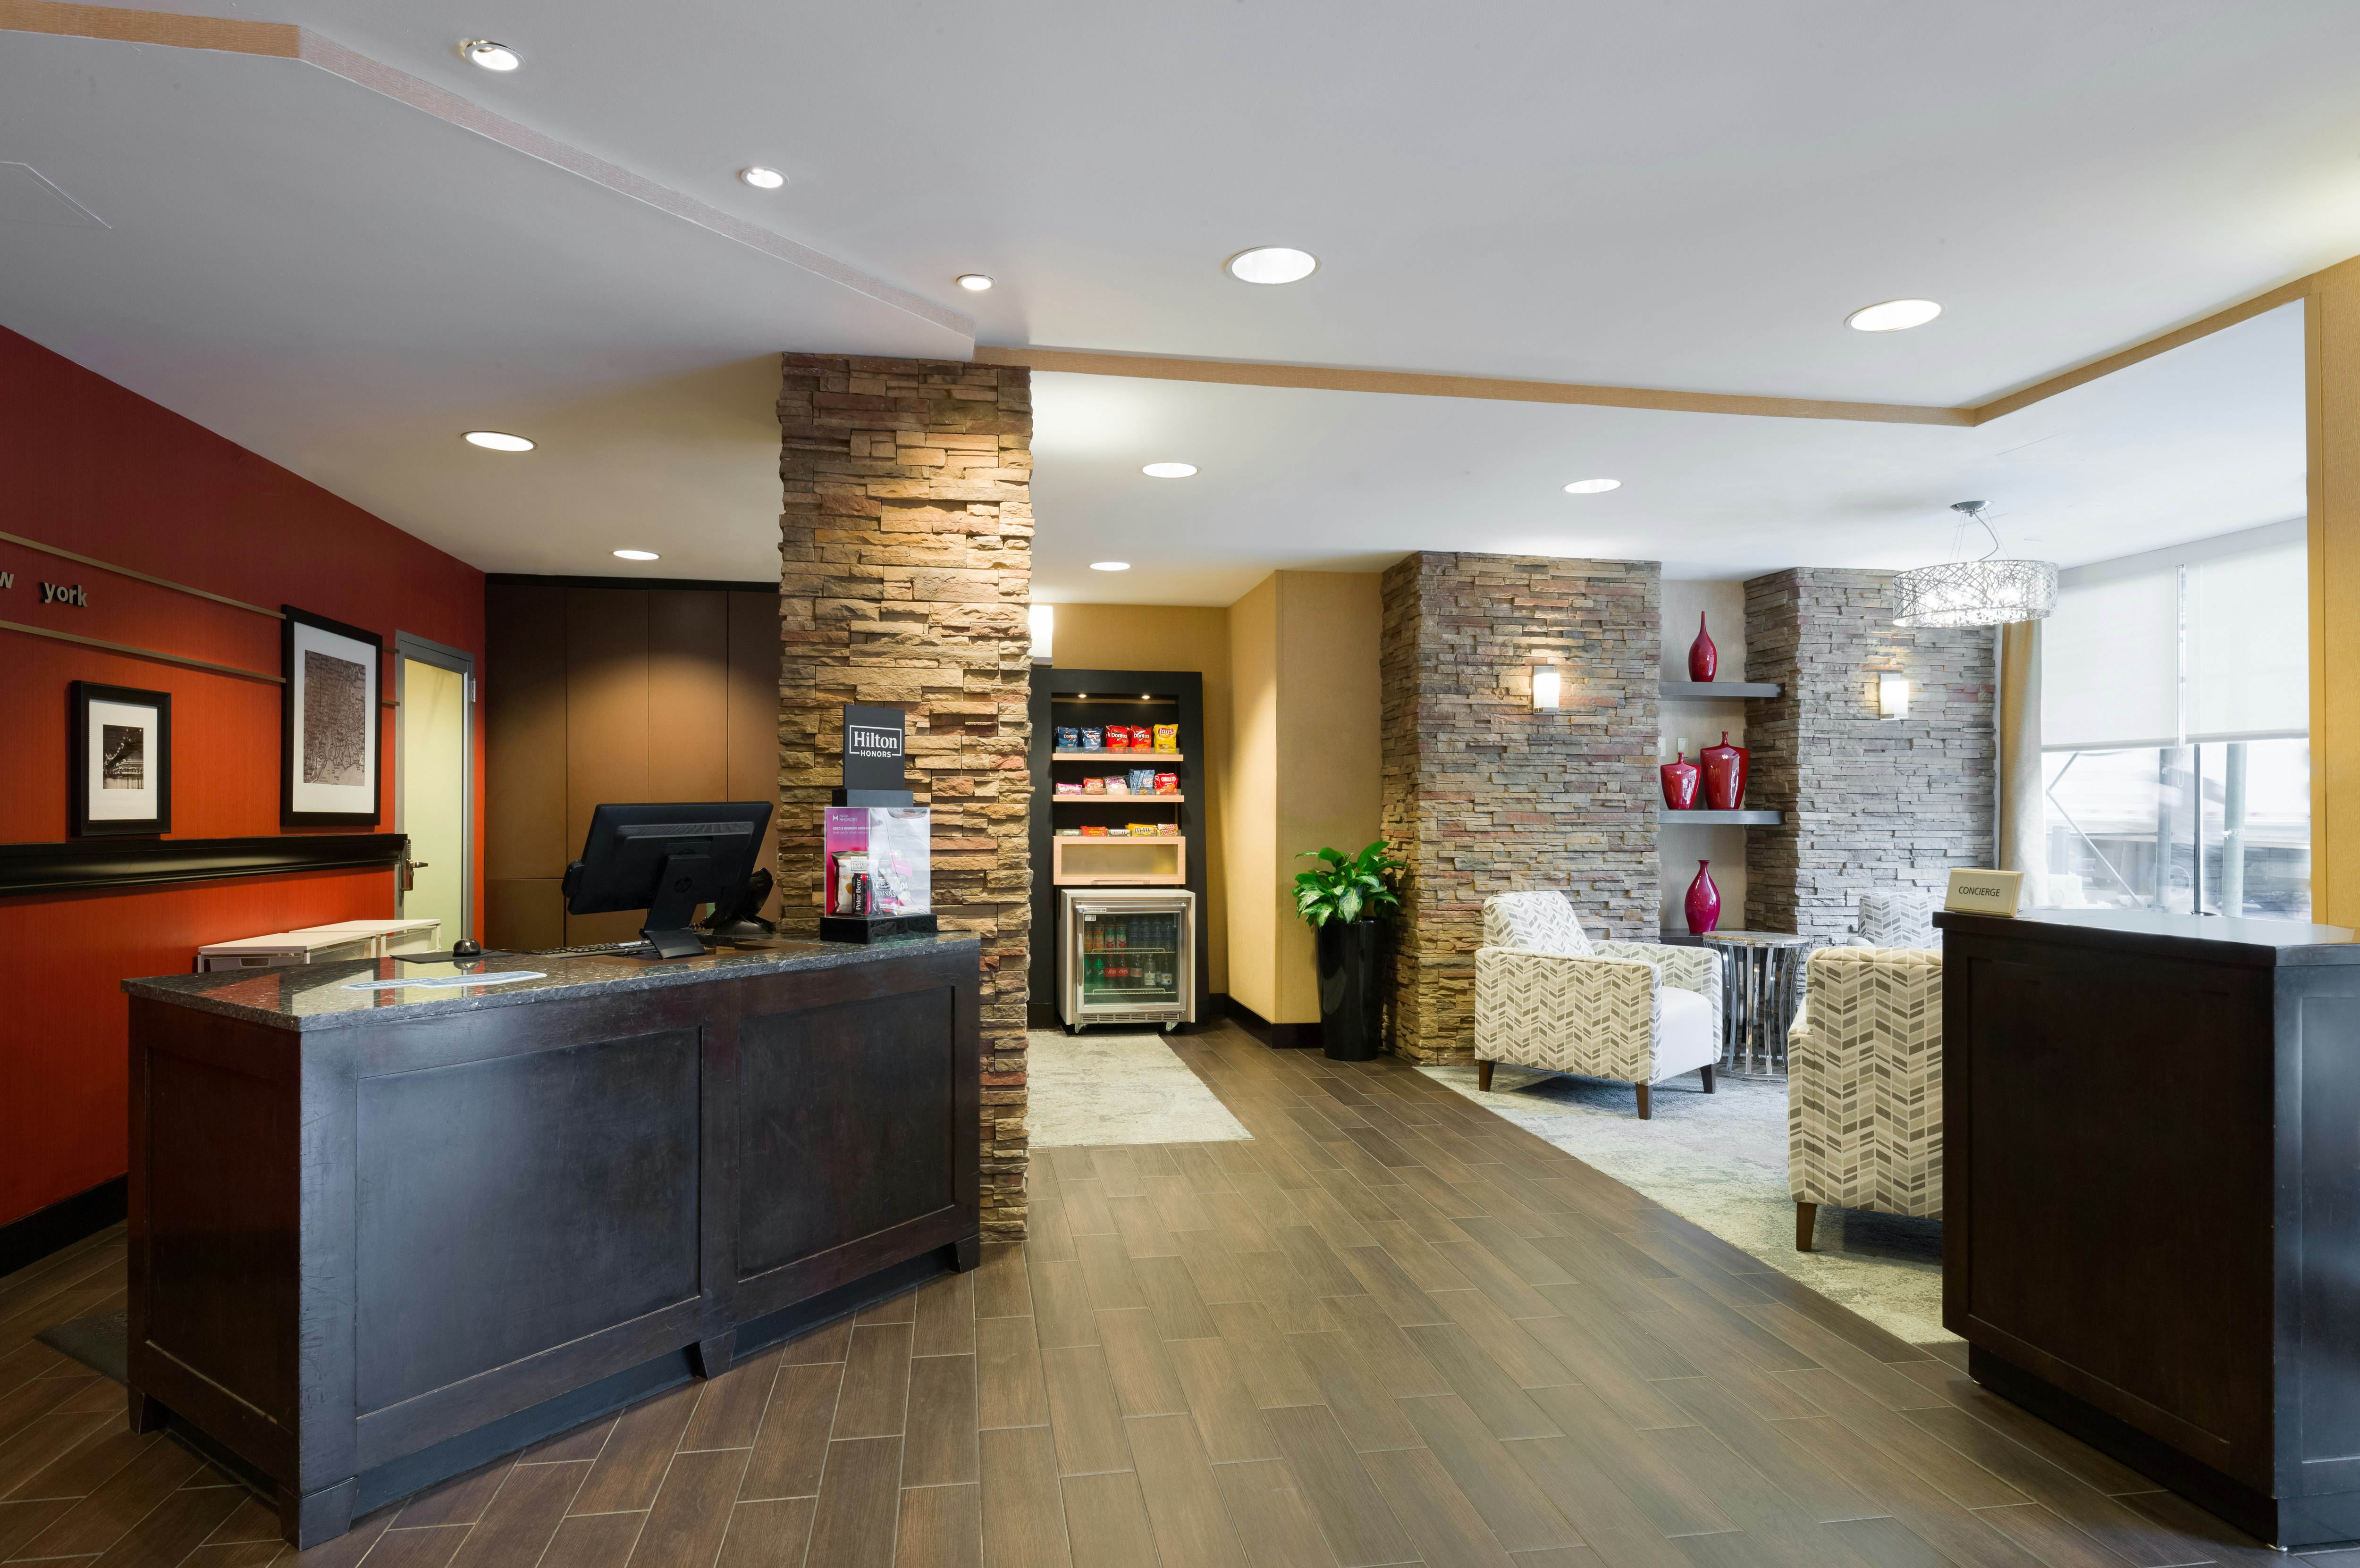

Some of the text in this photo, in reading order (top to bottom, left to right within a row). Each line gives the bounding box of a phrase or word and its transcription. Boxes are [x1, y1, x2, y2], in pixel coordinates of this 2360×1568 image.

[44, 582, 88, 607] york
[854, 731, 897, 748] Hilton
[860, 750, 891, 758] HONORS
[1958, 886, 2000, 897] CONCIERGE
